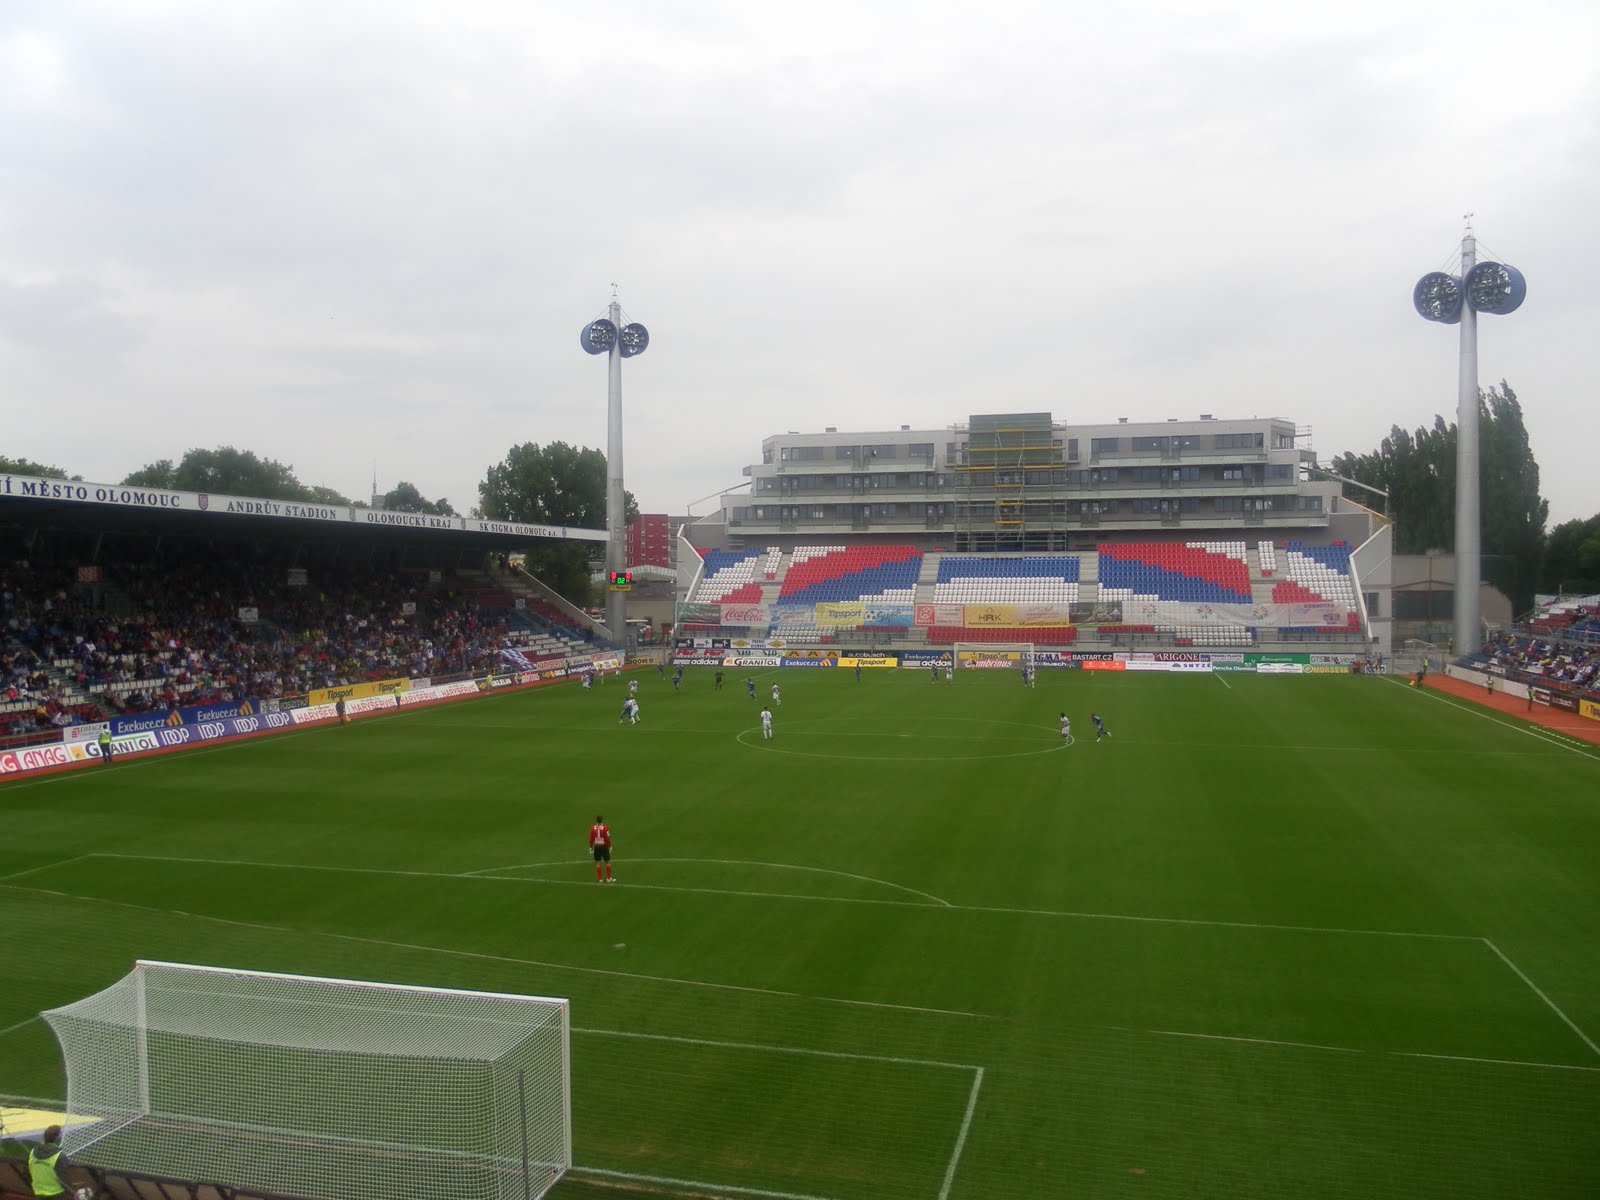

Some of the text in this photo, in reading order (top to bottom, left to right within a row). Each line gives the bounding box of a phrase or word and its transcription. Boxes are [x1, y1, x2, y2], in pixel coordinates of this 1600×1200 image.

[22, 479, 88, 500] MĚSTO
[96, 488, 180, 507] OLOMOUC
[227, 501, 336, 519] ANDRŮV STADION
[367, 512, 451, 528] OLOMOUCKÝ KRAJ
[480, 522, 489, 531] SK
[491, 523, 513, 533] SIGMA
[515, 526, 546, 536] OLOMOUC
[828, 610, 861, 618] Tipsport
[734, 658, 778, 666] GRANITOL
[785, 659, 818, 667] Exekuce.cz
[1072, 653, 1112, 661] BASTART.CZ
[1157, 653, 1198, 661] ARIGONE
[327, 688, 353, 700] Tipsport
[197, 708, 238, 722] Exekuce.cz
[118, 719, 165, 733] Exekuce.cz
[24, 746, 67, 769] ANAG
